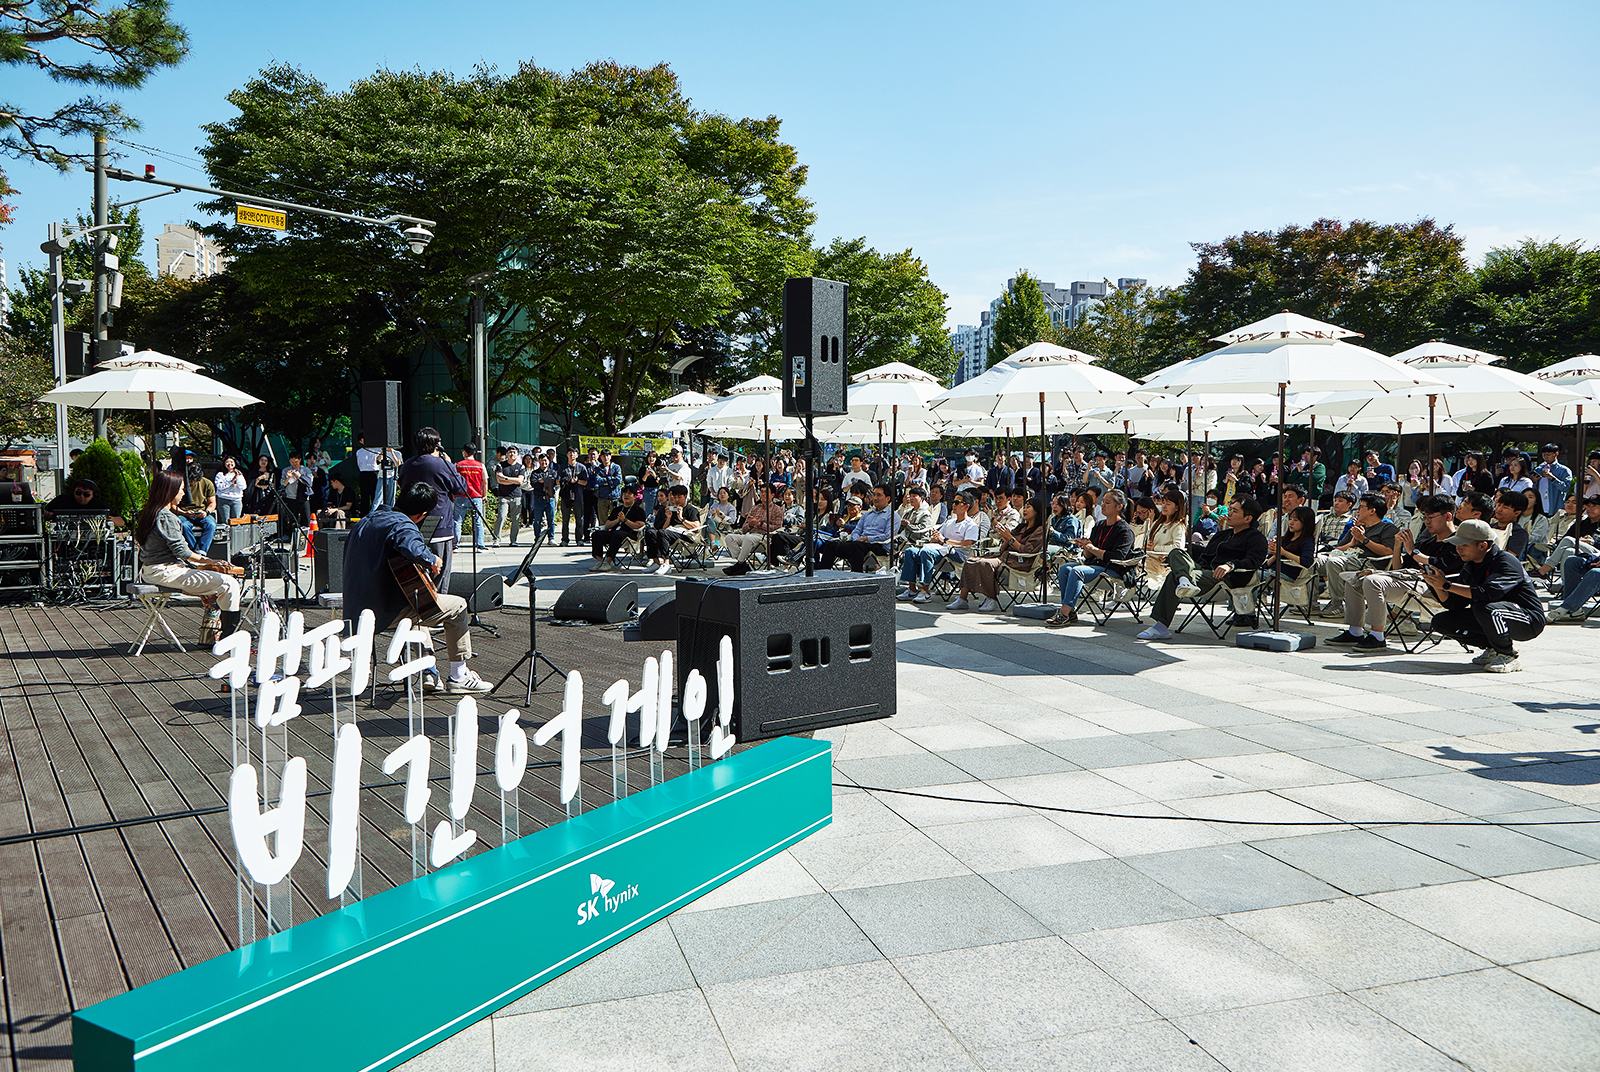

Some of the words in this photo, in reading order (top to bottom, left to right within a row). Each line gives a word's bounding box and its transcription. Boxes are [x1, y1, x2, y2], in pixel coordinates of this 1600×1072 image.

[209, 608, 436, 727] 캠퍼스
[577, 896, 600, 925] SK
[605, 884, 639, 913] hynix
